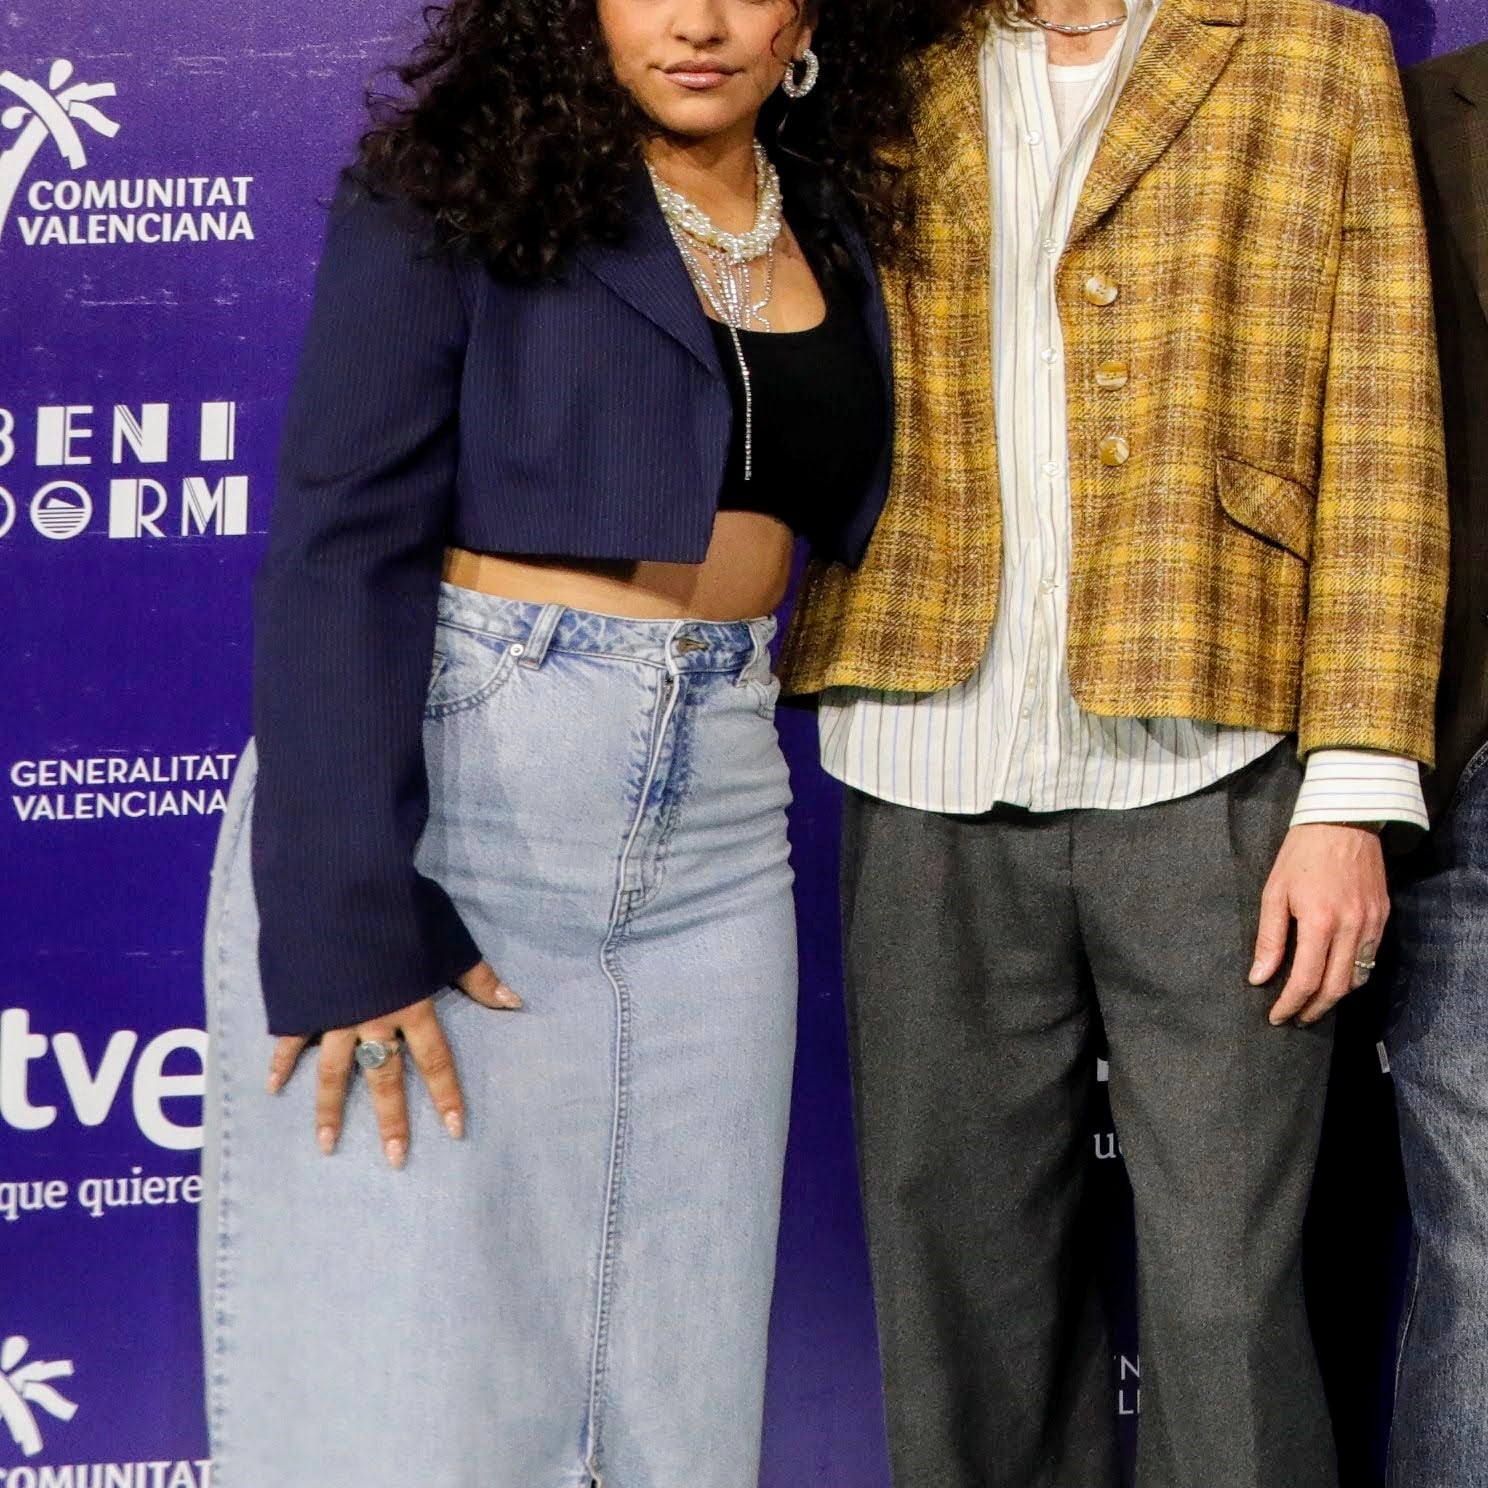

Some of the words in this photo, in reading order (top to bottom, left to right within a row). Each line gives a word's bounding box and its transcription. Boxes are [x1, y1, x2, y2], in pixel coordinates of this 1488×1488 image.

[28, 176, 253, 209] COMUNITAT
[18, 211, 254, 245] VALENCIANA
[10, 755, 236, 787] GENERALITAT
[12, 789, 228, 821] VALENCIANA
[78, 1166, 203, 1217] quiere
